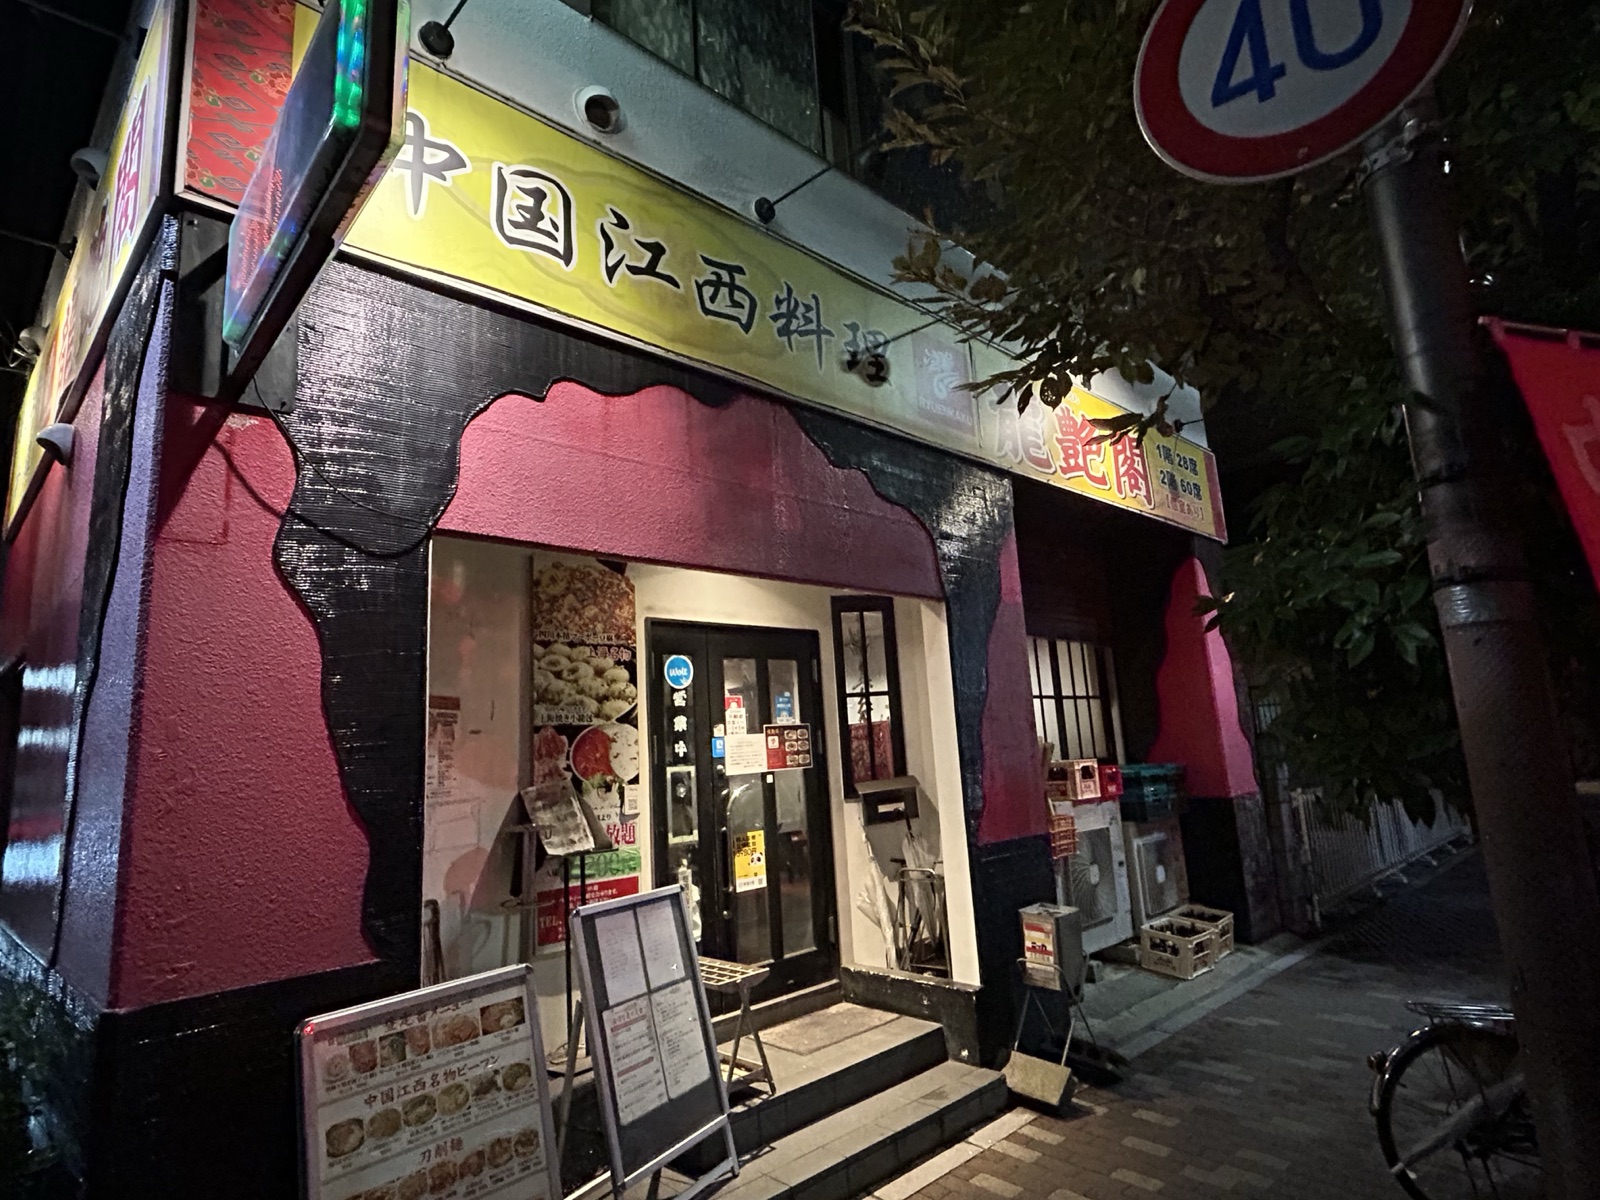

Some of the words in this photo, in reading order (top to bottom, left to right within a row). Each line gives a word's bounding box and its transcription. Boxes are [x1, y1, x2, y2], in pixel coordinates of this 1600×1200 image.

[1211, 0, 1385, 107] 40
[394, 111, 892, 386] 中国江西料理
[1156, 444, 1174, 465] 1階
[1176, 453, 1199, 476] 28席
[1180, 479, 1203, 501] 60席
[669, 667, 689, 677] Wolt
[672, 690, 688, 757] 営業中
[362, 1055, 500, 1108] 中国江西名物ビーフン
